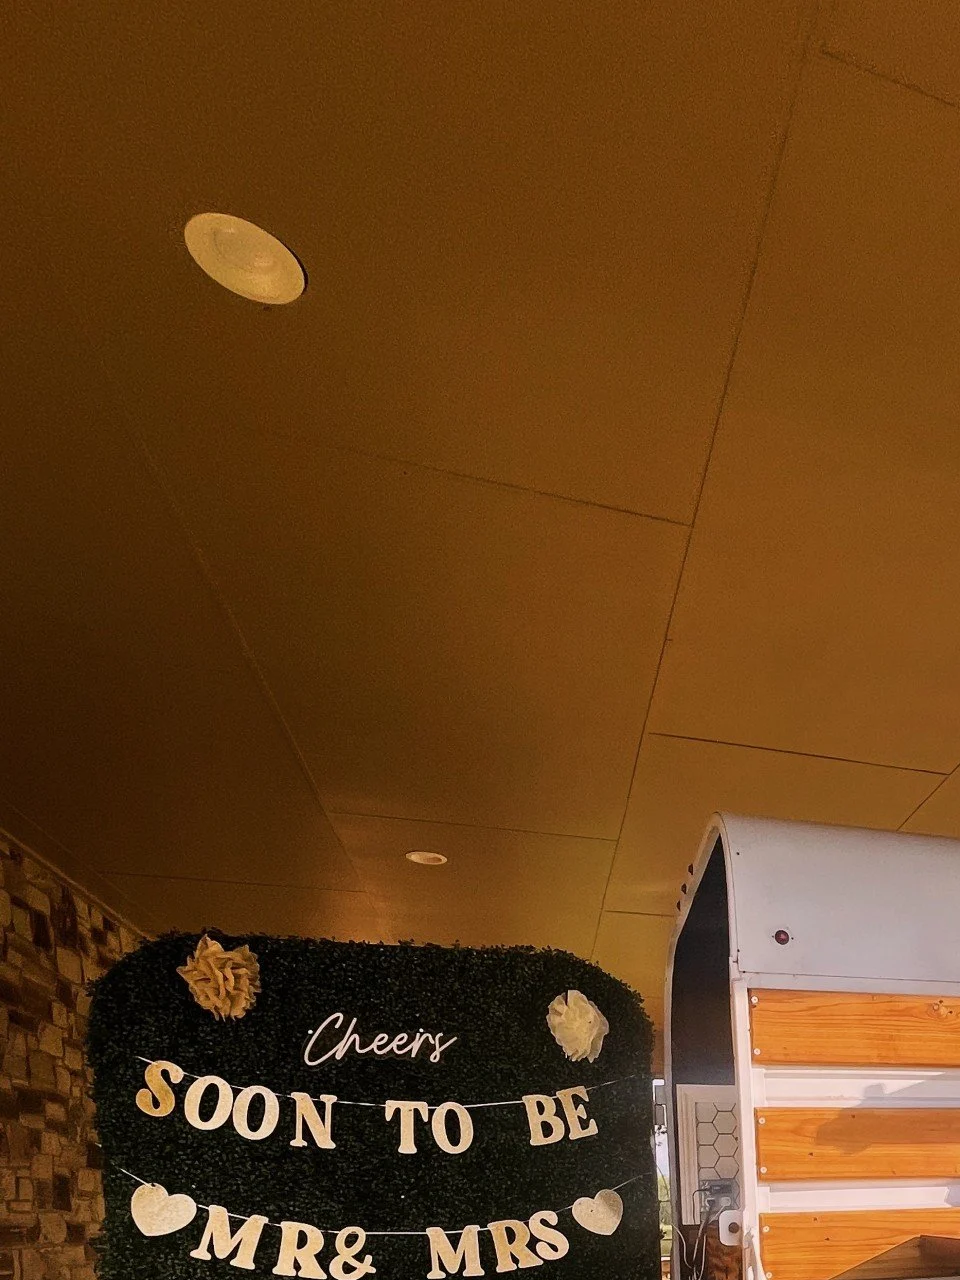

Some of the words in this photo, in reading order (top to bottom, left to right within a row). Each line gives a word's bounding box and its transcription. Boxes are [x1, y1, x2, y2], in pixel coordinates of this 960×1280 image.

[303, 1012, 457, 1066] Cheers
[135, 1059, 337, 1149] SOON
[384, 1099, 474, 1154] TO
[523, 1086, 599, 1146] BE
[190, 1204, 377, 1280] MR&
[426, 1210, 570, 1279] MRS
